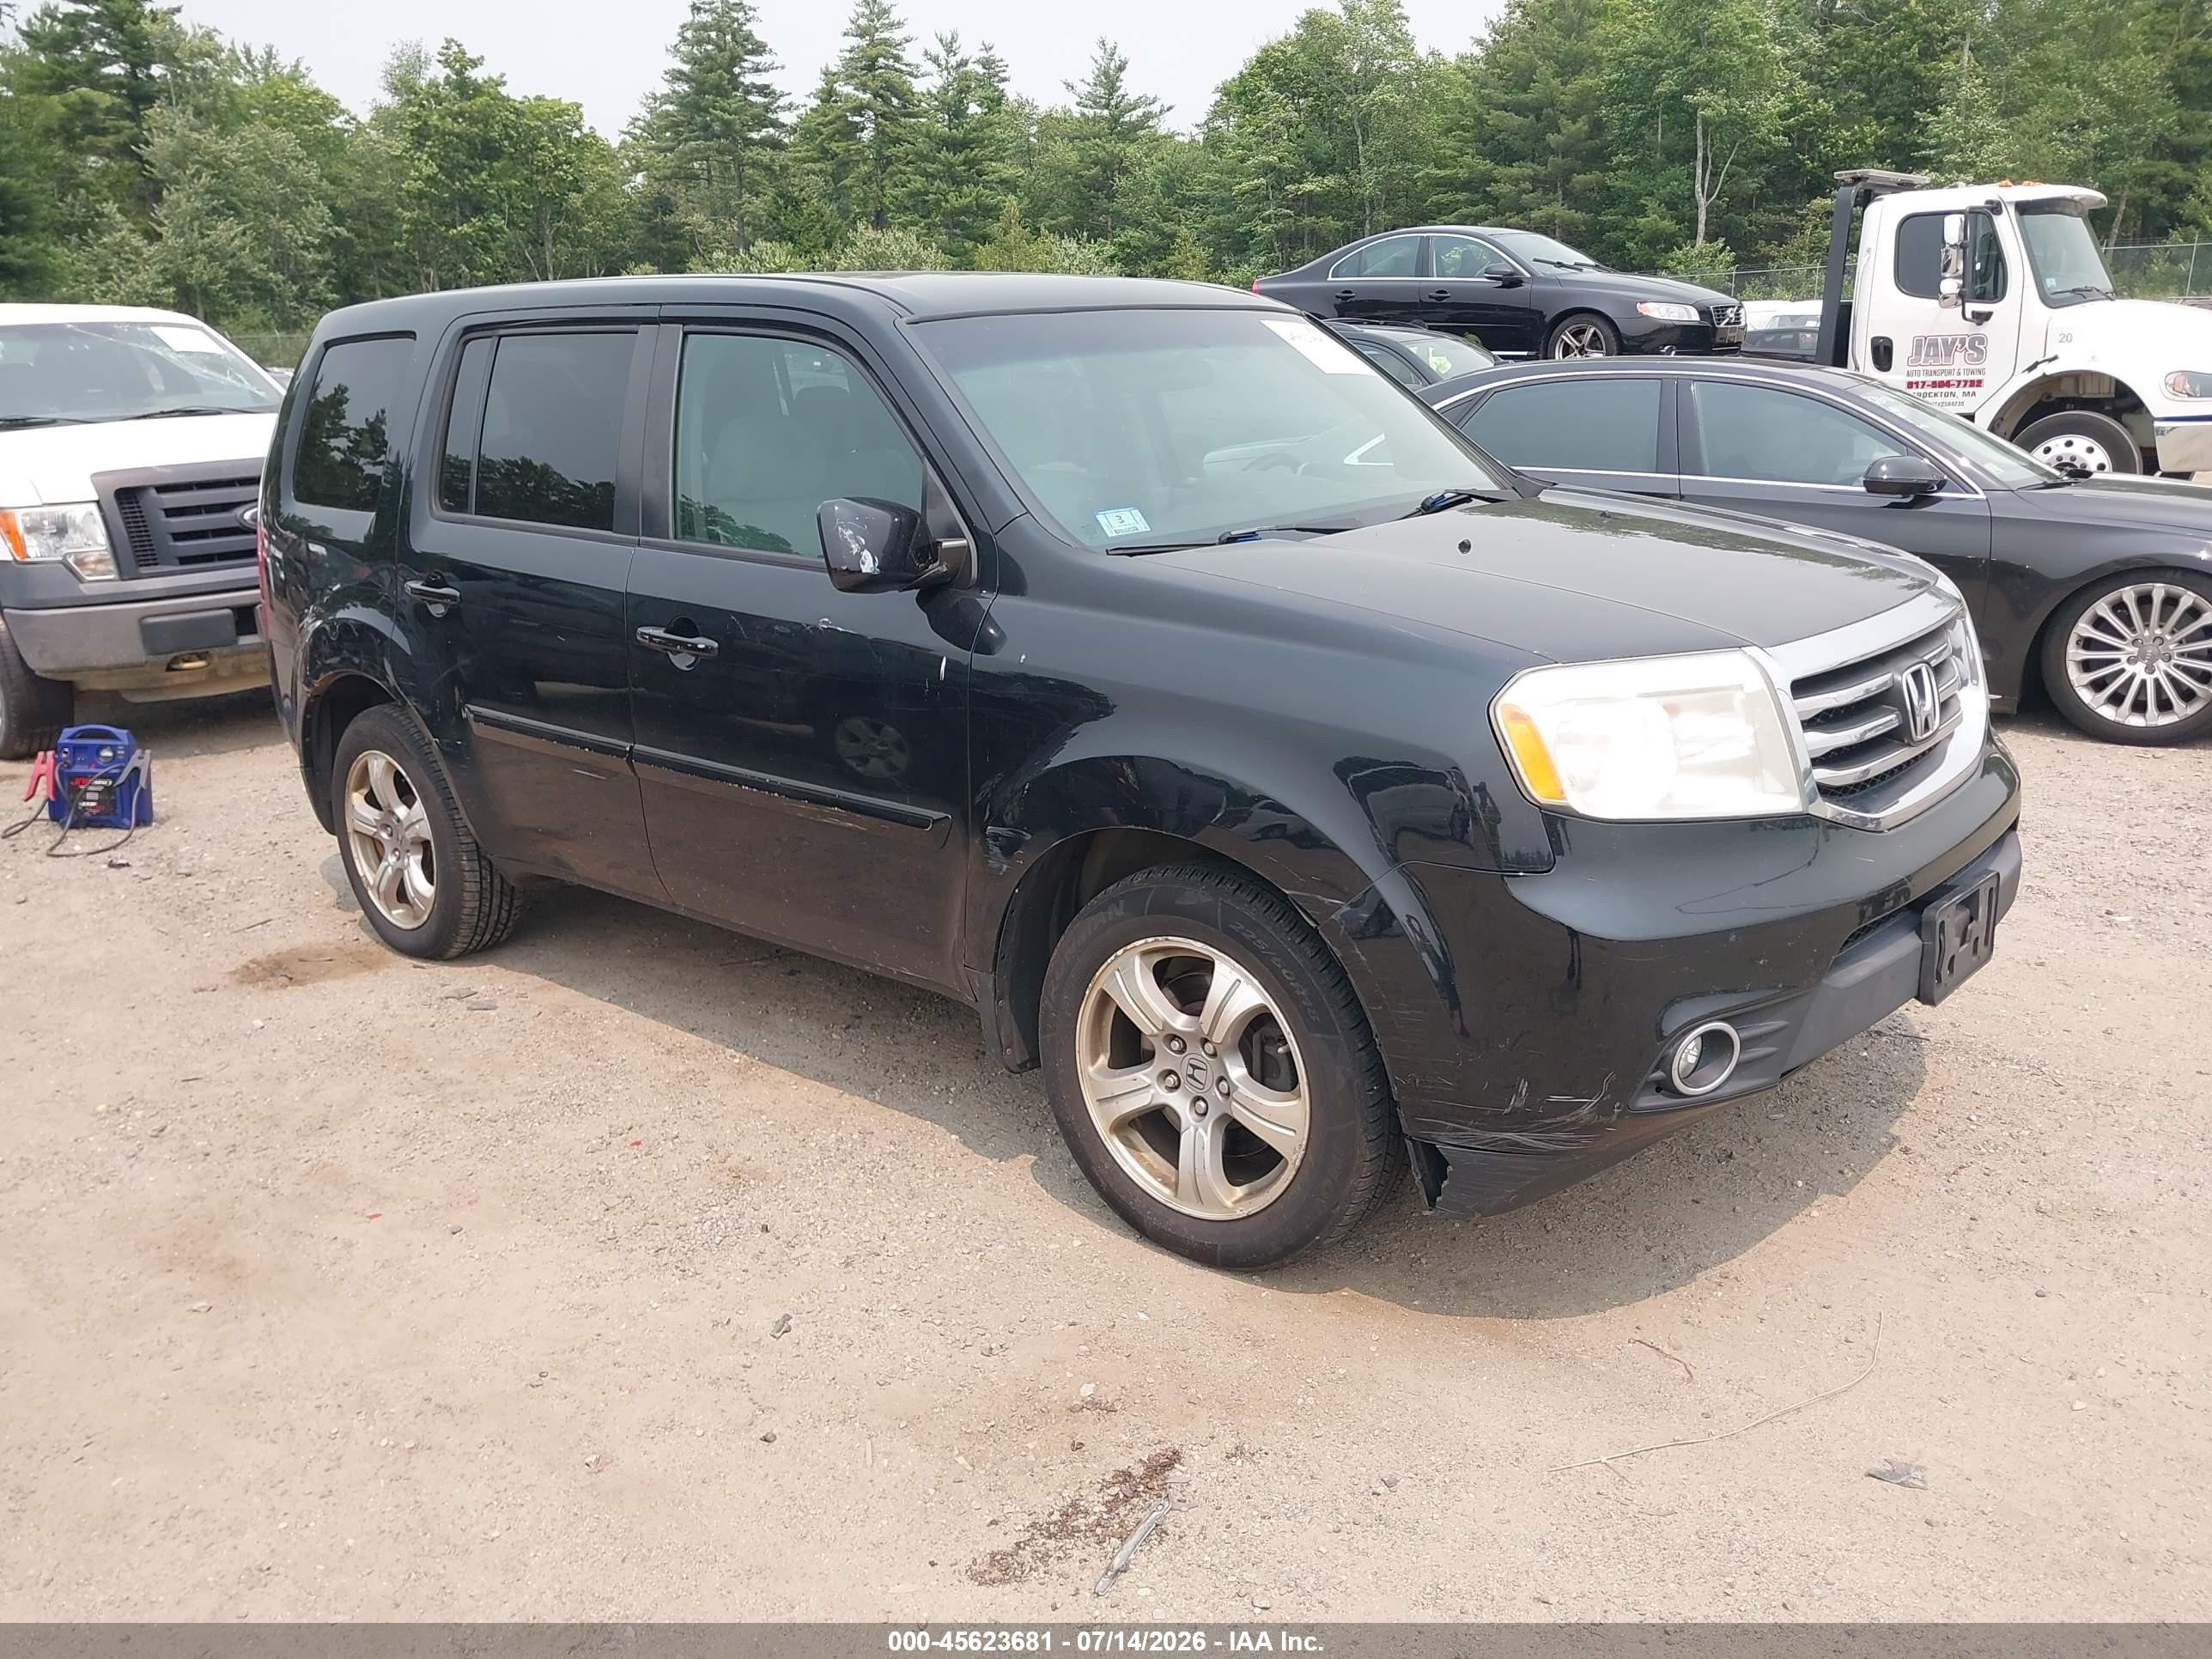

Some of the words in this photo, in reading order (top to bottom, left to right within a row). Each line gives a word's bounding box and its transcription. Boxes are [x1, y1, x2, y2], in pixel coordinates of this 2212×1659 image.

[2058, 332, 2074, 343] 20
[1907, 333, 1988, 367] JAY'S
[1922, 368, 1955, 377] TRANSPORT
[1963, 368, 1986, 376] TOWING
[1115, 515, 1125, 524] 3
